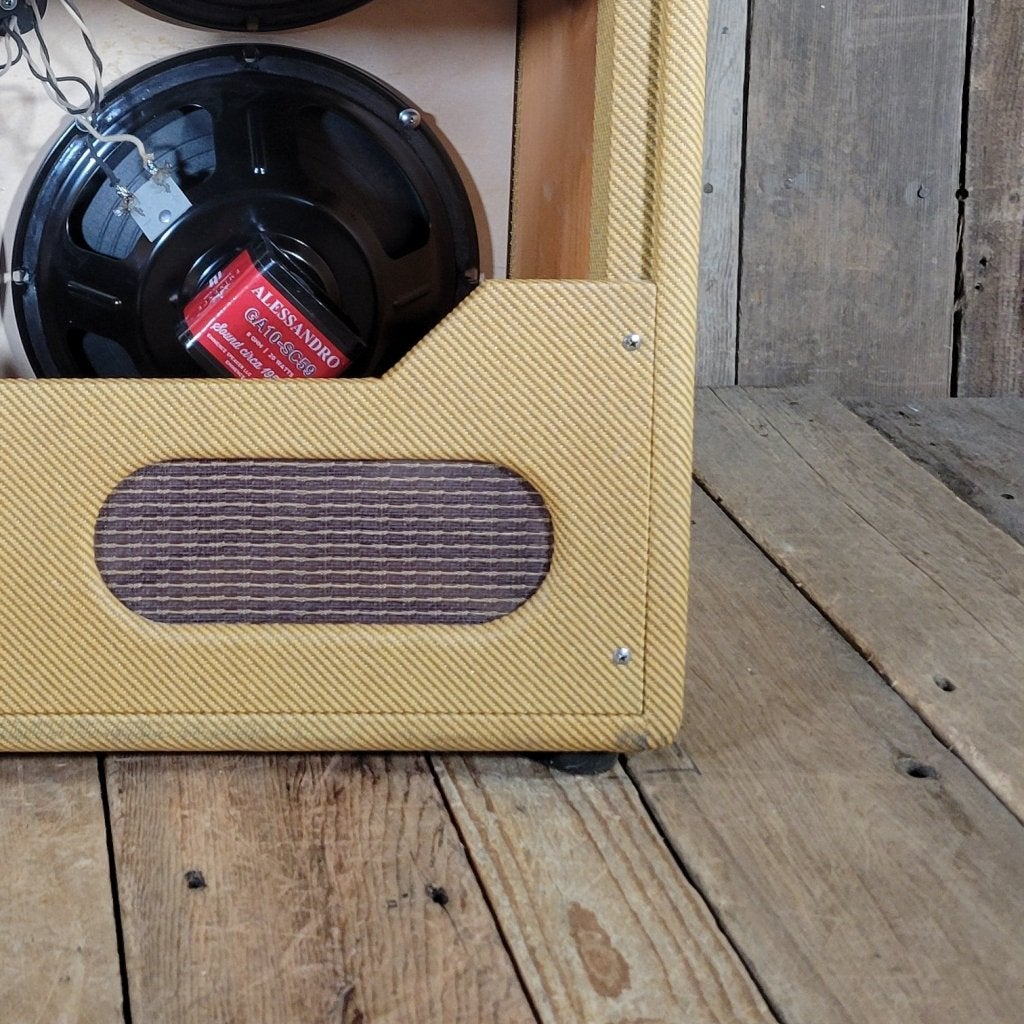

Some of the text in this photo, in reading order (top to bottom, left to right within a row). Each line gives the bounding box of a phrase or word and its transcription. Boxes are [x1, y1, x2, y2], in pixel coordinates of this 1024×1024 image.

[210, 321, 243, 349] Sound
[239, 346, 261, 369] circa
[245, 307, 317, 377] GA10-SC59
[250, 285, 340, 369] ALESSANDRO
